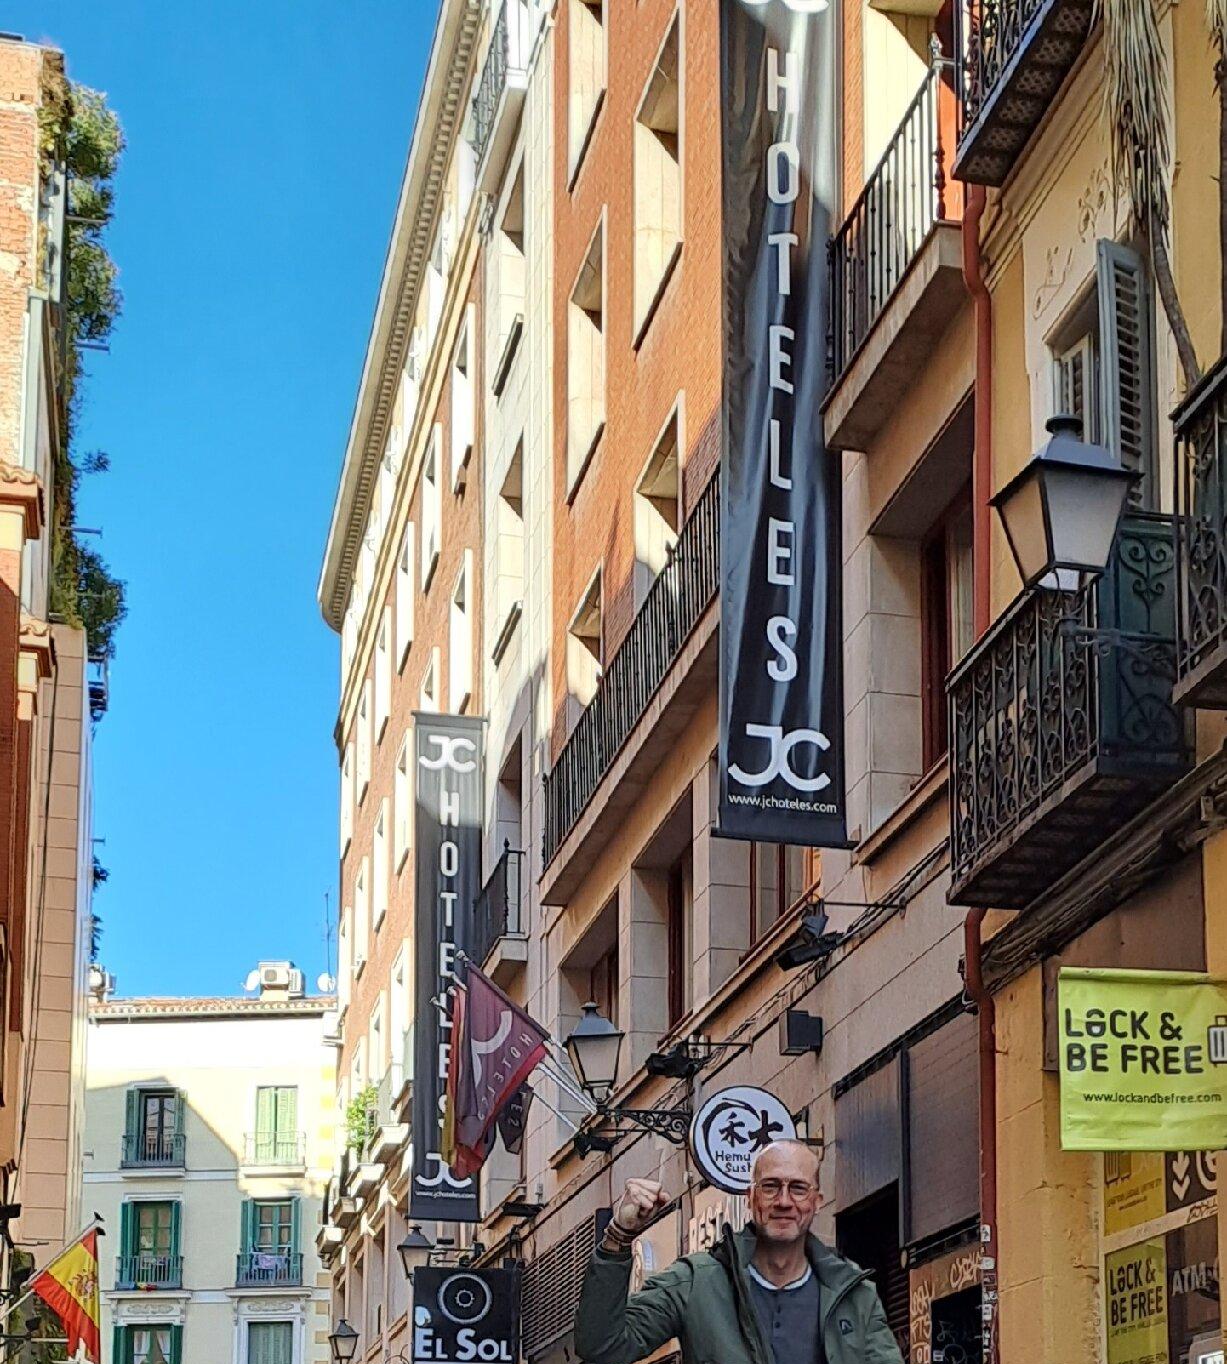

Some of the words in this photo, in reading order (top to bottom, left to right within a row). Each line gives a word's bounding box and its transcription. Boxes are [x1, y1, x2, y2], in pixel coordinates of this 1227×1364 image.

[766, 47, 800, 683] HOTELES
[418, 734, 477, 774] JC
[727, 722, 831, 792] JC
[728, 794, 837, 814] www.jchoteles.com
[1064, 1007, 1151, 1040] LOCK
[1160, 1011, 1183, 1042] &
[1066, 1042, 1109, 1073] BE
[1121, 1044, 1205, 1075] FREE
[1083, 1091, 1222, 1105] www.lockandbefree.com
[715, 1150, 751, 1162] Hemu
[1109, 1259, 1143, 1297] LOCK
[1111, 1297, 1128, 1327] BE
[1130, 1285, 1164, 1322] FREE
